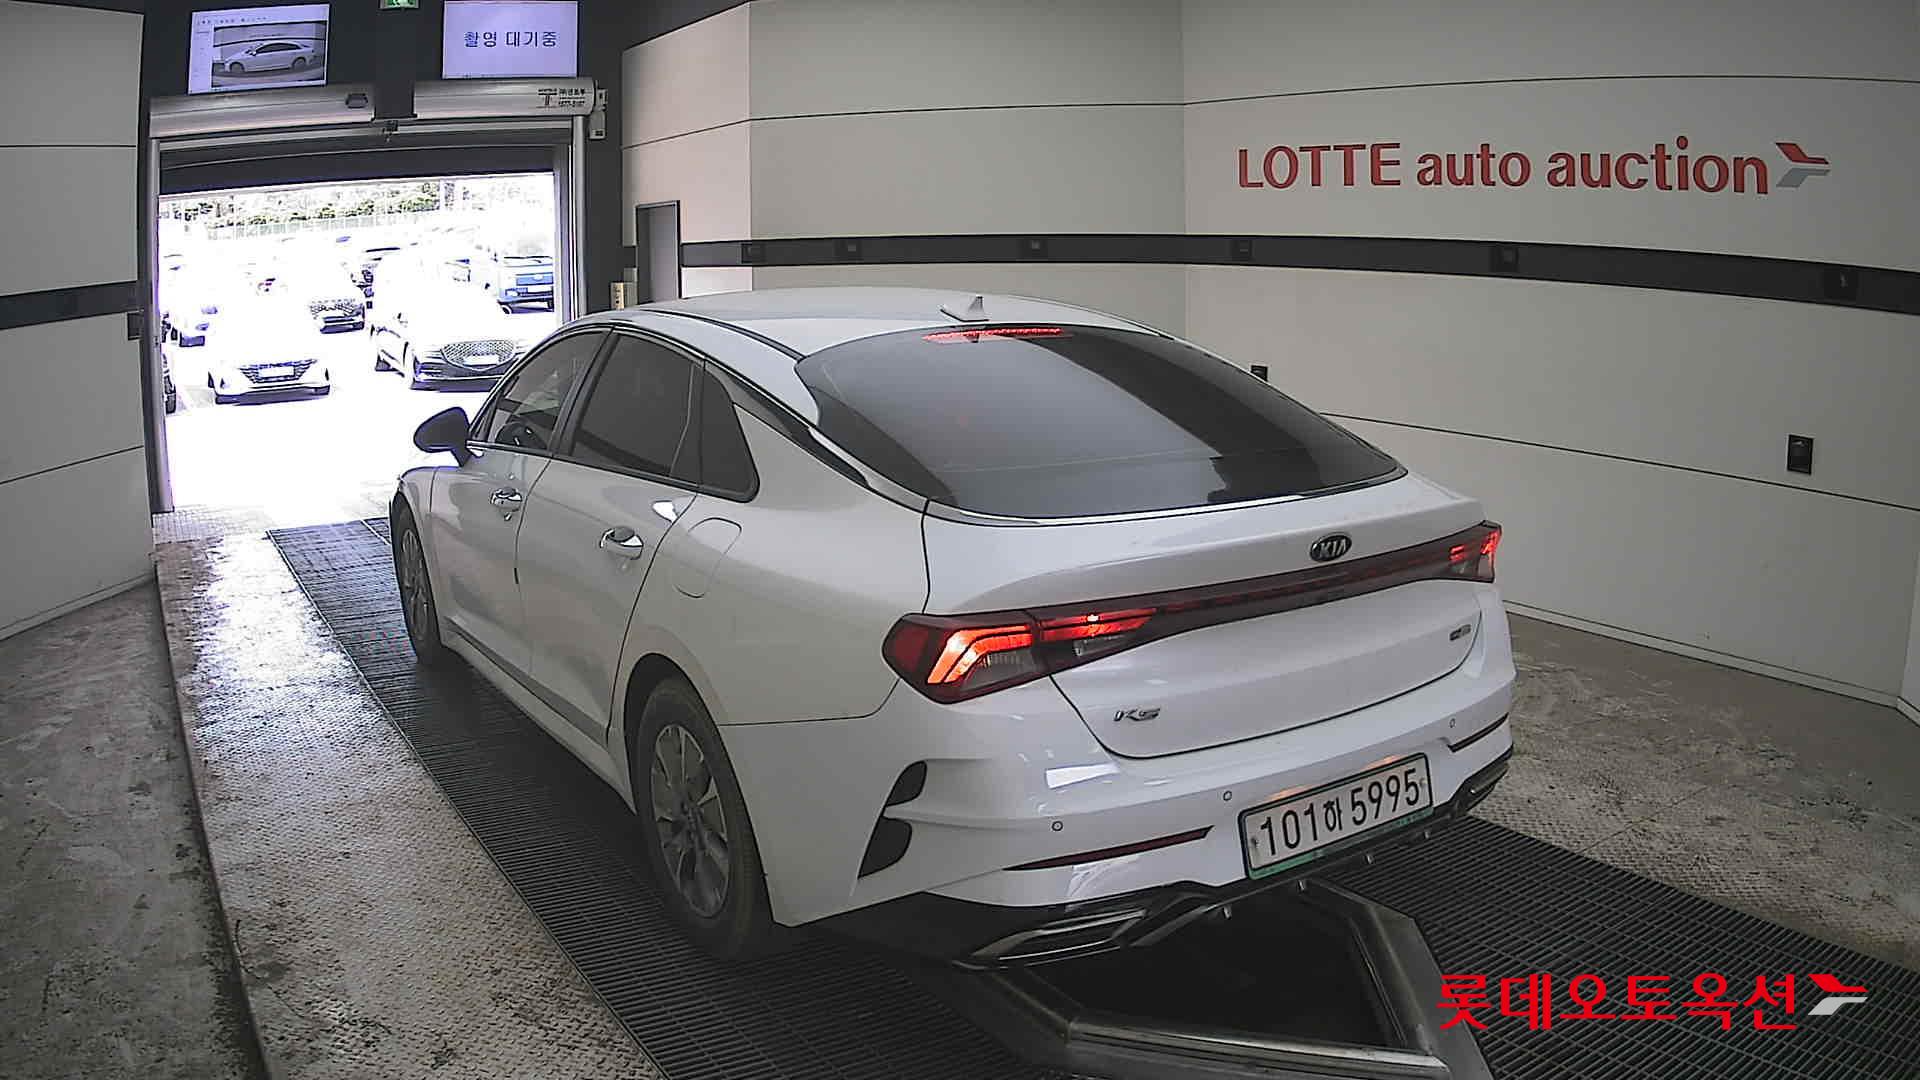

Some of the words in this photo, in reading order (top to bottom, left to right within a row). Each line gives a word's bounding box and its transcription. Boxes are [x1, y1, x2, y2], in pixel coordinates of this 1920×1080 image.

[464, 31, 498, 48] 촬영
[505, 31, 558, 48] 대기중
[1238, 142, 1400, 189] LOTTE
[1416, 143, 1532, 187] auto
[1546, 135, 1769, 195] auction
[1260, 797, 1343, 856] 101하
[1350, 768, 1420, 826] 5995
